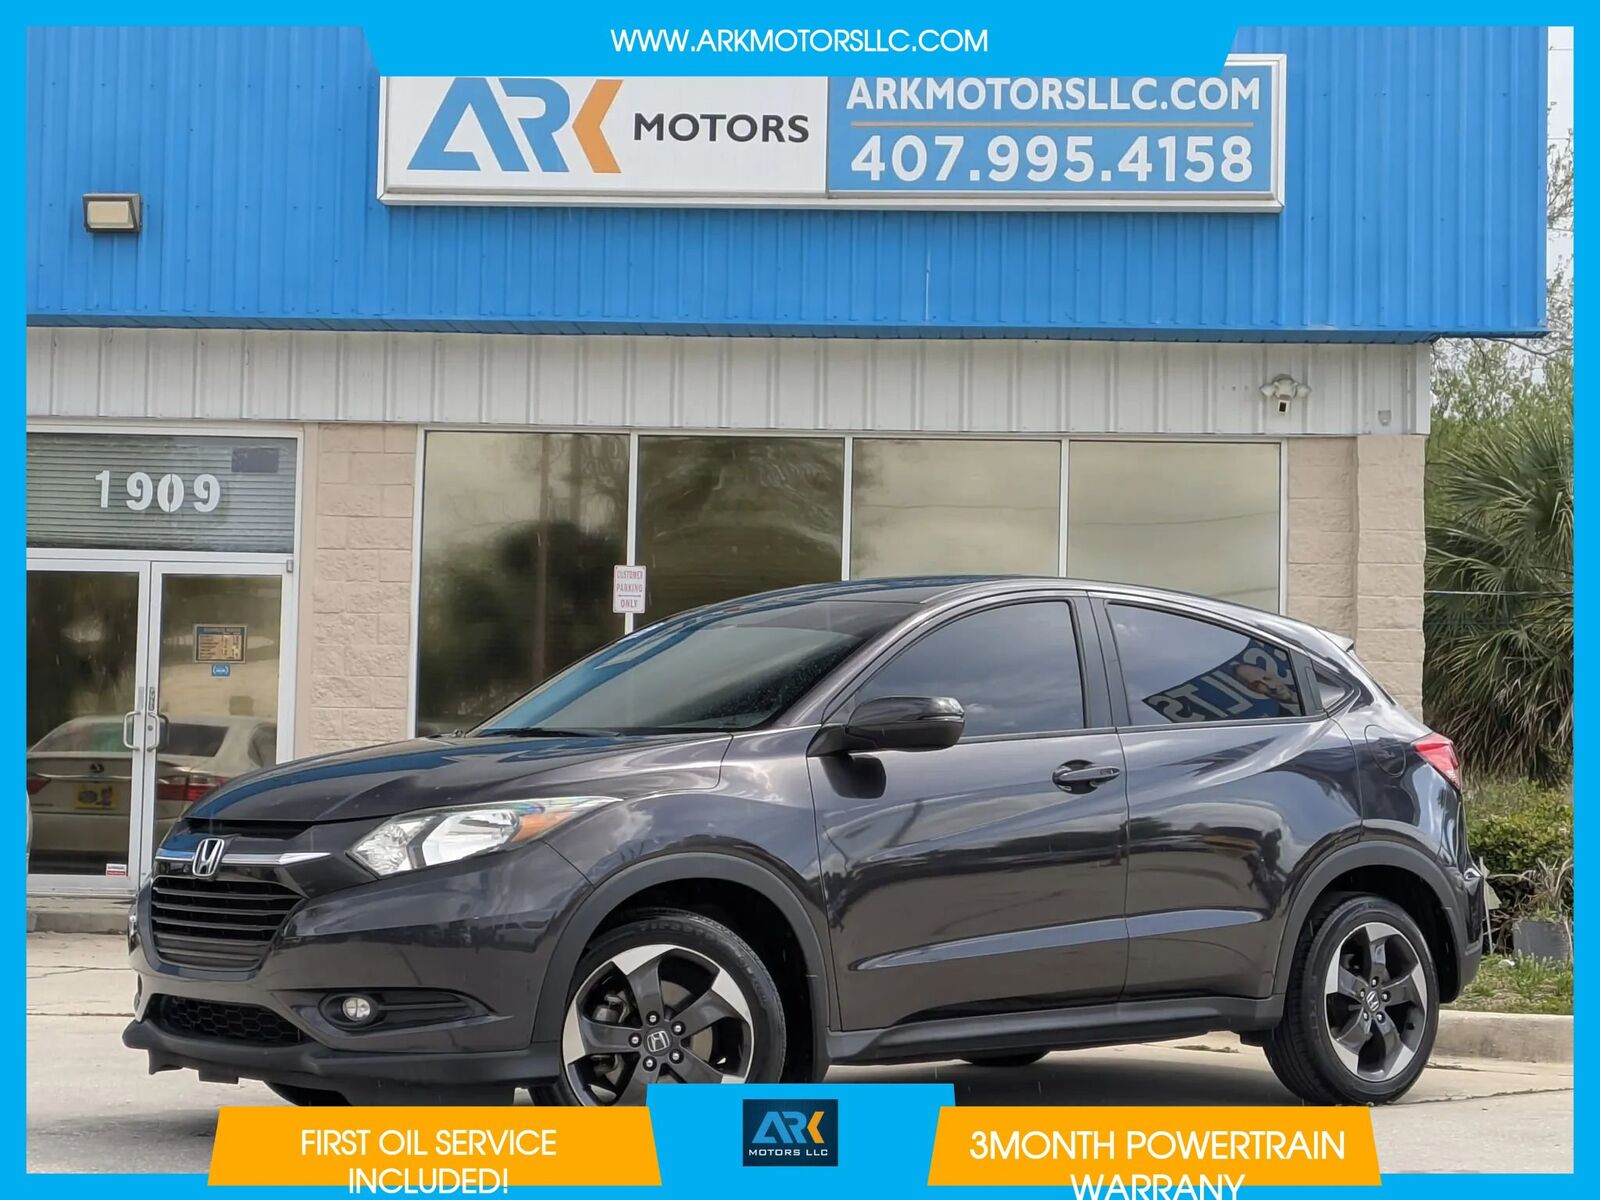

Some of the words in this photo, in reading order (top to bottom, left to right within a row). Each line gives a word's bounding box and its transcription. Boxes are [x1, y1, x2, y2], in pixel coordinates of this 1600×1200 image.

[846, 76, 1260, 110] ARKMOTORSLLC.COM
[407, 77, 624, 173] ARK
[634, 113, 809, 142] MOTORS
[851, 135, 1253, 182] 407.995.4158
[95, 470, 220, 512] 1909
[616, 583, 643, 592] PARKING
[620, 599, 638, 608] ONLY
